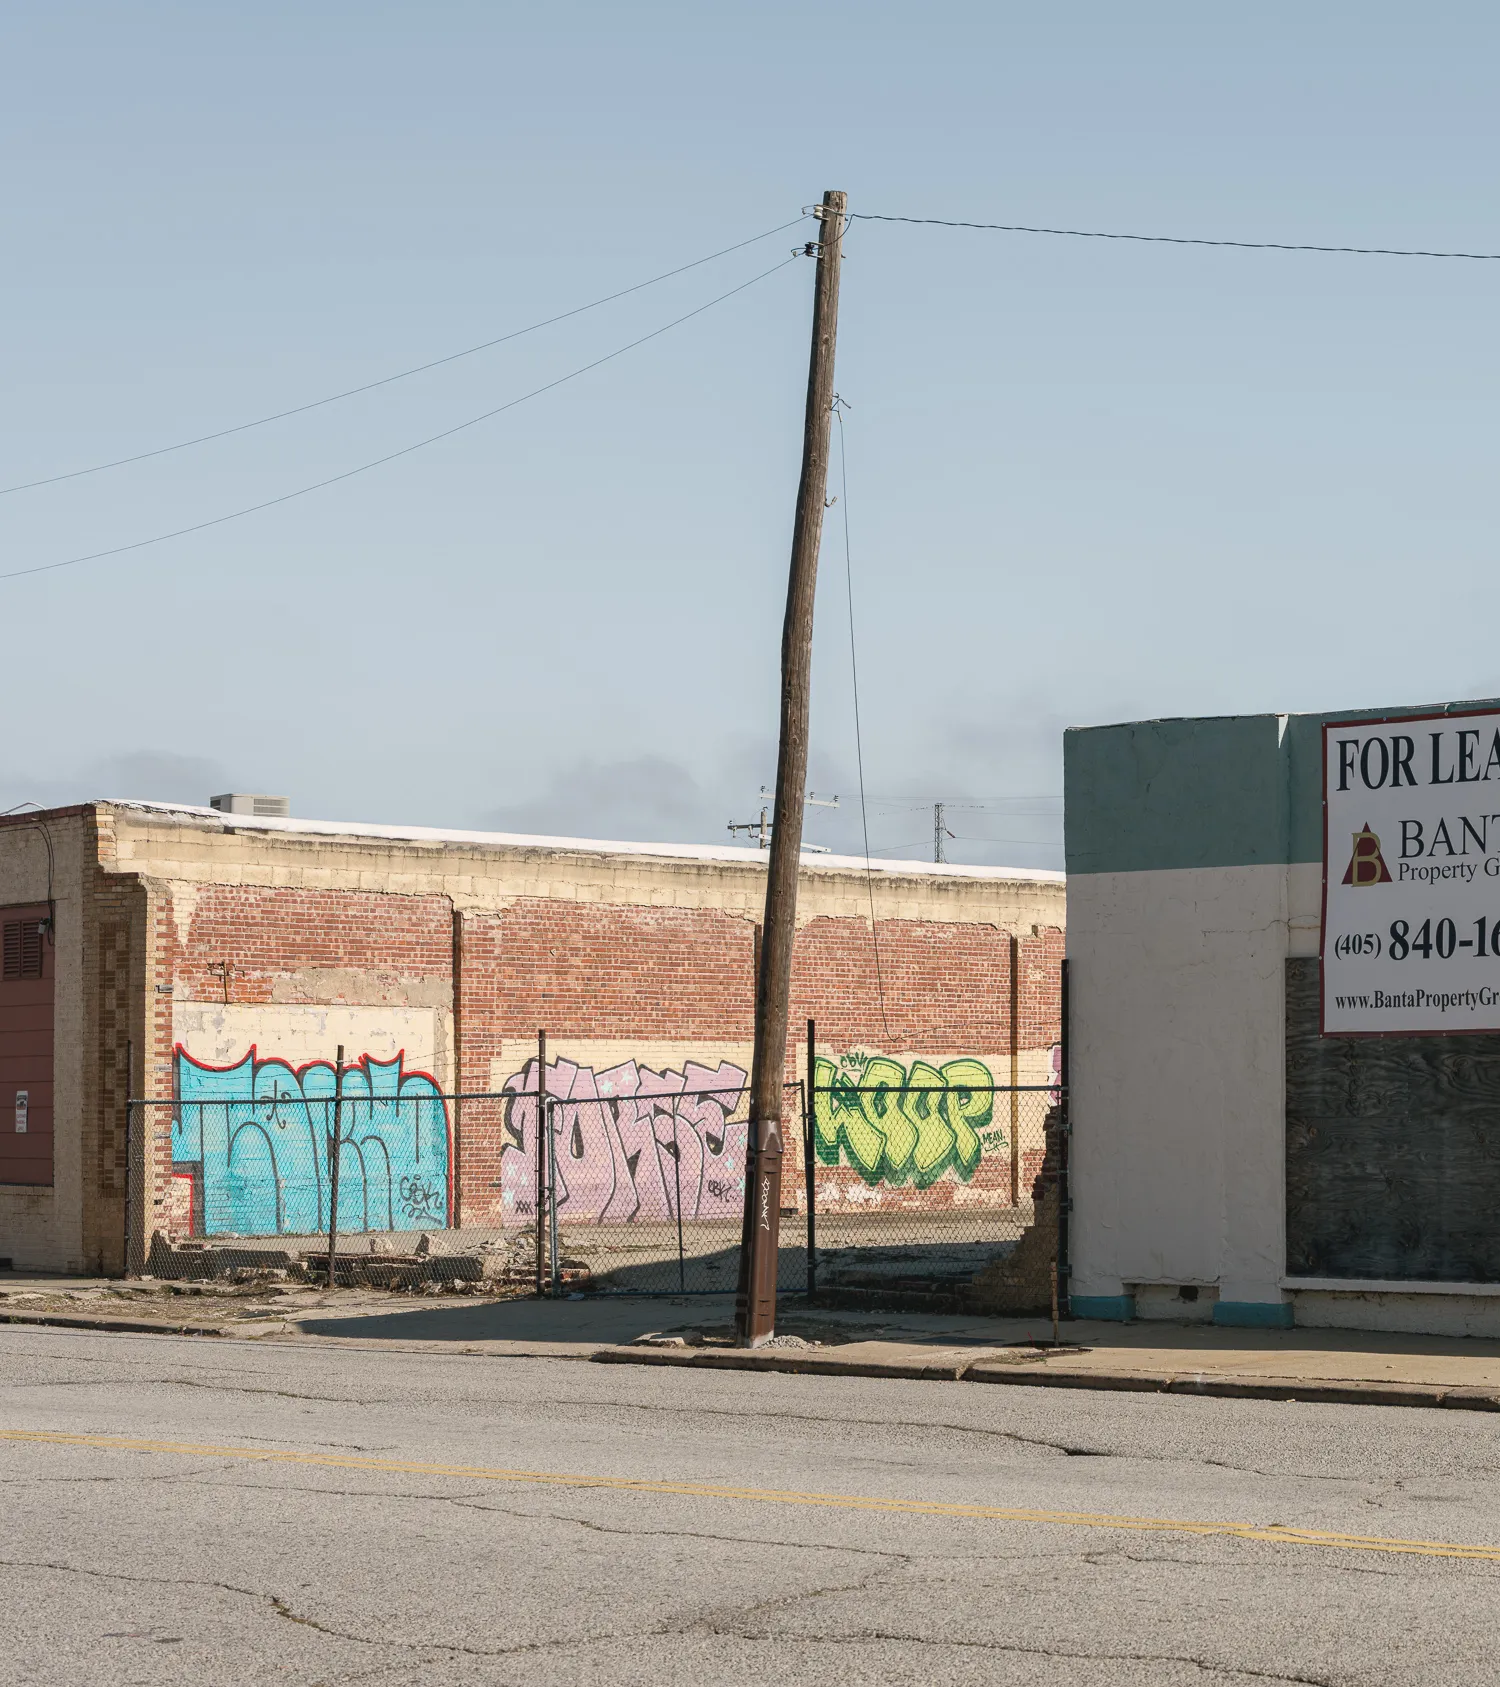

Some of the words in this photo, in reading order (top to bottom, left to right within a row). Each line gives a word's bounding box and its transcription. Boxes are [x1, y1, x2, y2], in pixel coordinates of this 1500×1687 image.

[1336, 735, 1418, 791] FOR
[1398, 862, 1478, 885] Property
[1334, 932, 1381, 960] (405)
